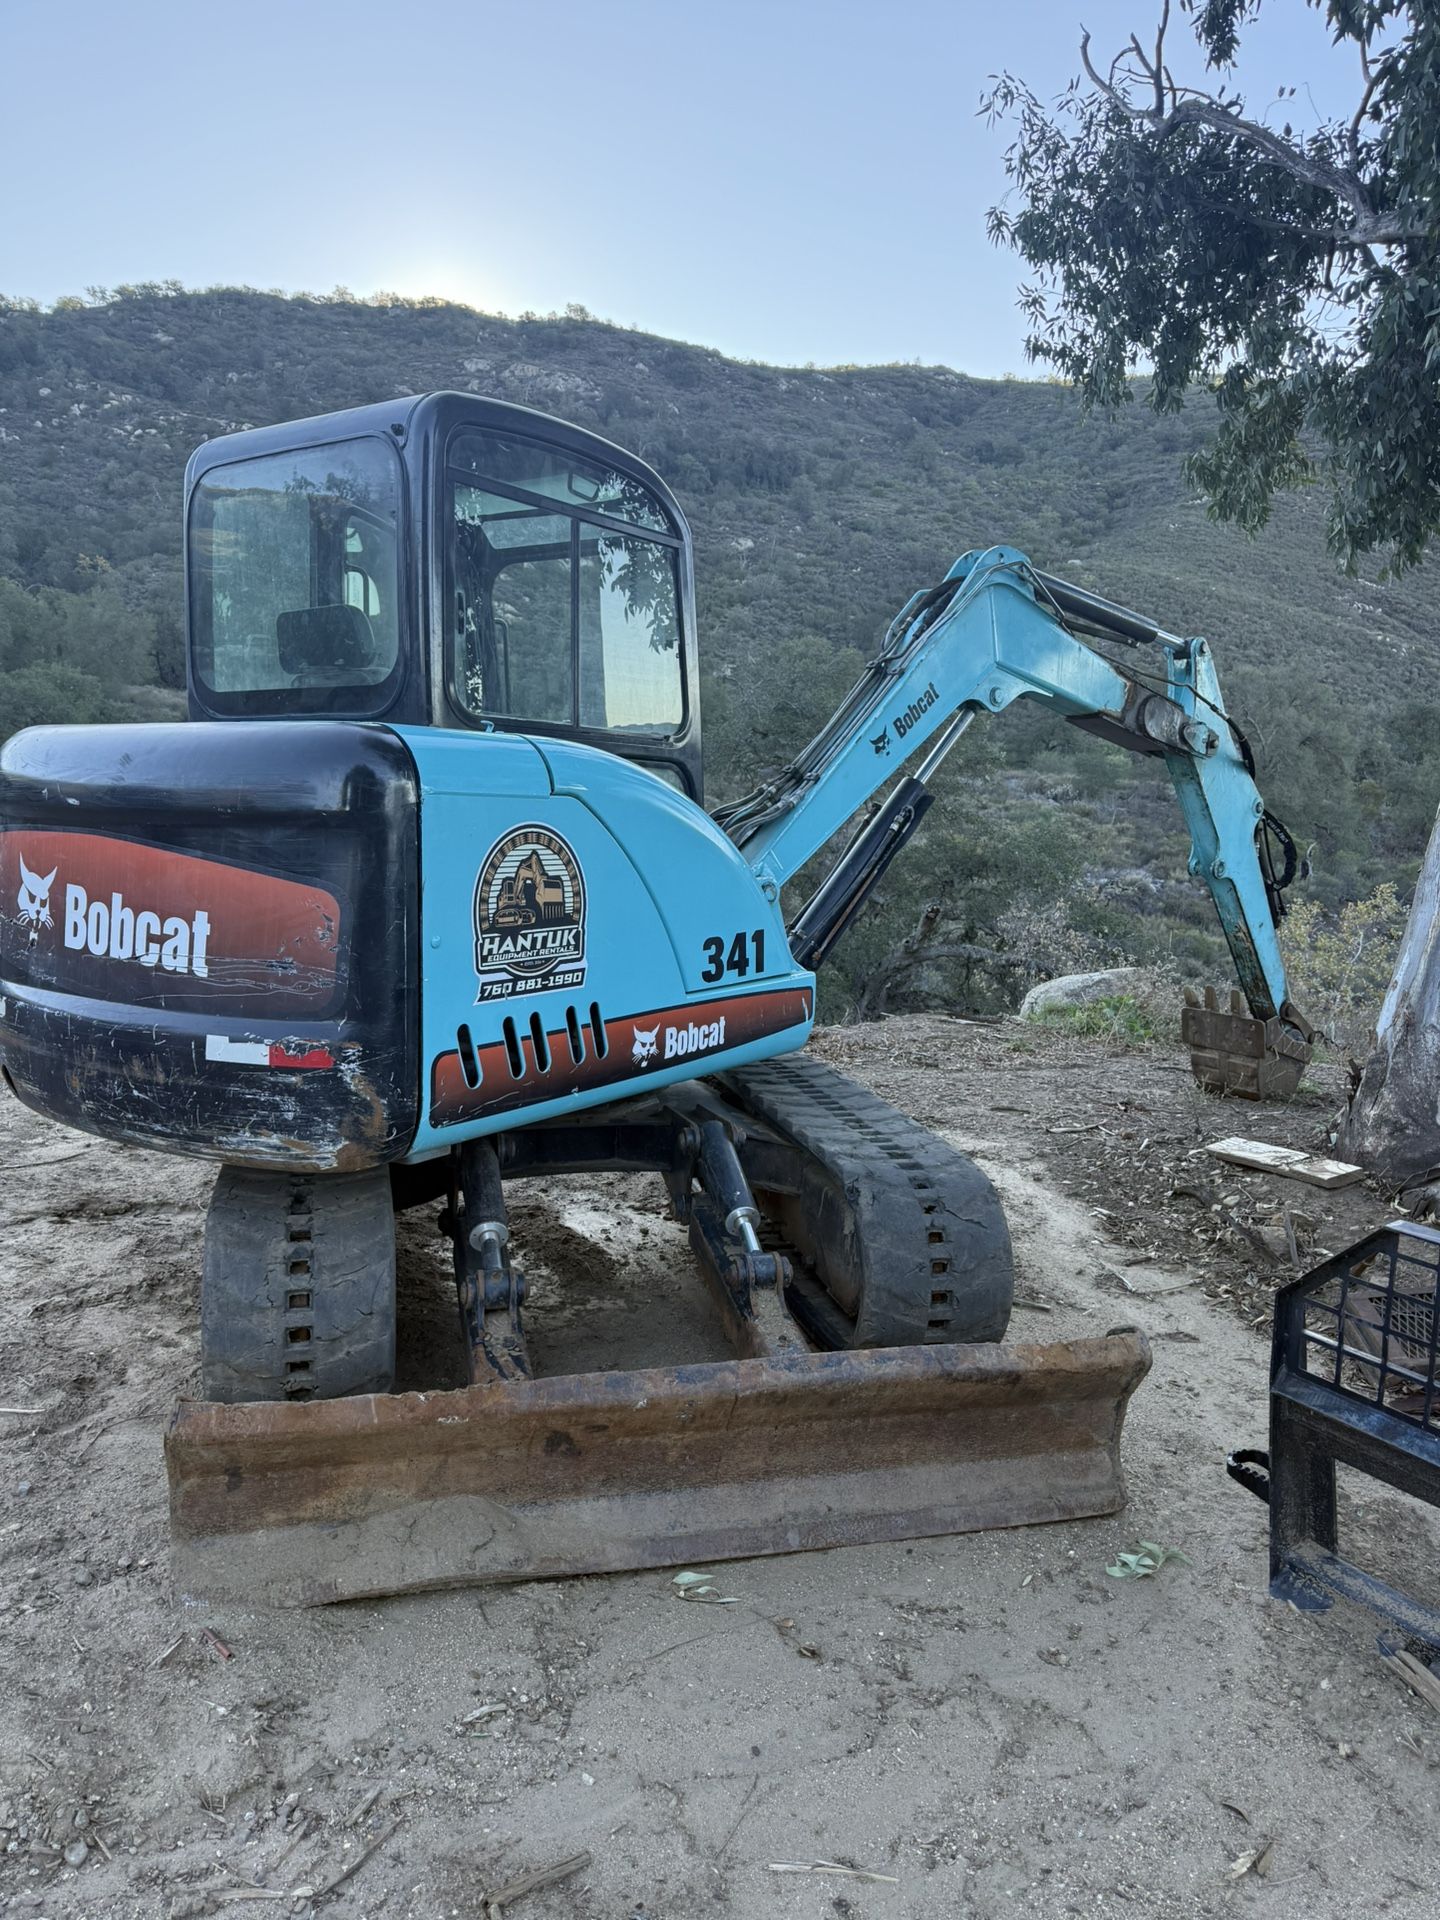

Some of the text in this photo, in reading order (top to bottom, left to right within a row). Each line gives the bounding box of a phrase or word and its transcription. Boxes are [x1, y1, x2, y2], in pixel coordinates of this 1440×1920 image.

[892, 681, 940, 739] Bobcat
[64, 883, 211, 978] Bobcat
[482, 929, 577, 956] HANTUK
[487, 945, 575, 962] EQUIPMENT RENTALS
[701, 929, 765, 984] 341
[483, 971, 583, 997] 760 881-1990
[664, 1016, 726, 1060] Bobcat
